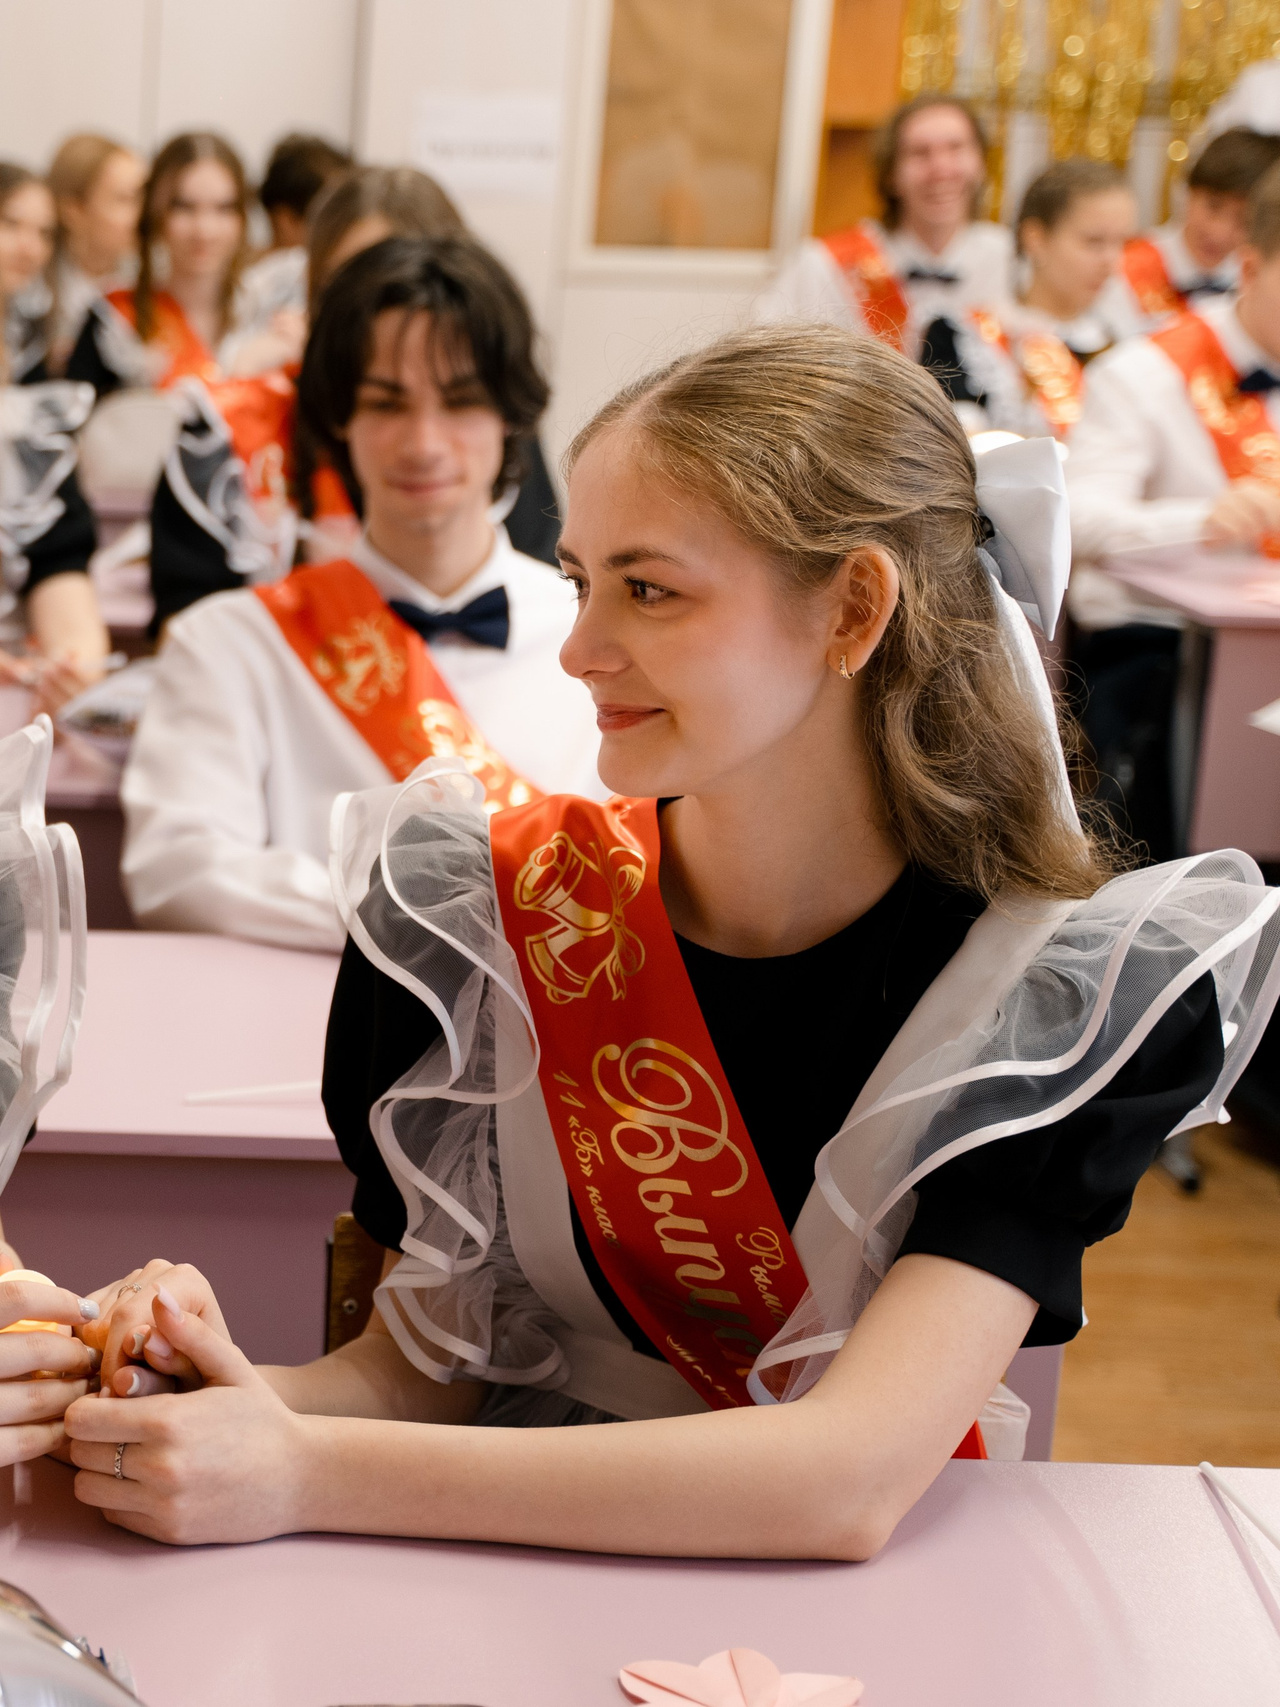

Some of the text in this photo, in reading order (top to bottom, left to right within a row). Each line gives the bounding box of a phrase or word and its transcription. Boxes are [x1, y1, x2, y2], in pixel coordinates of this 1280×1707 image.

[553, 1070, 586, 1109] 11
[568, 1115, 604, 1177] «Б»
[735, 1226, 789, 1330] Рыма
